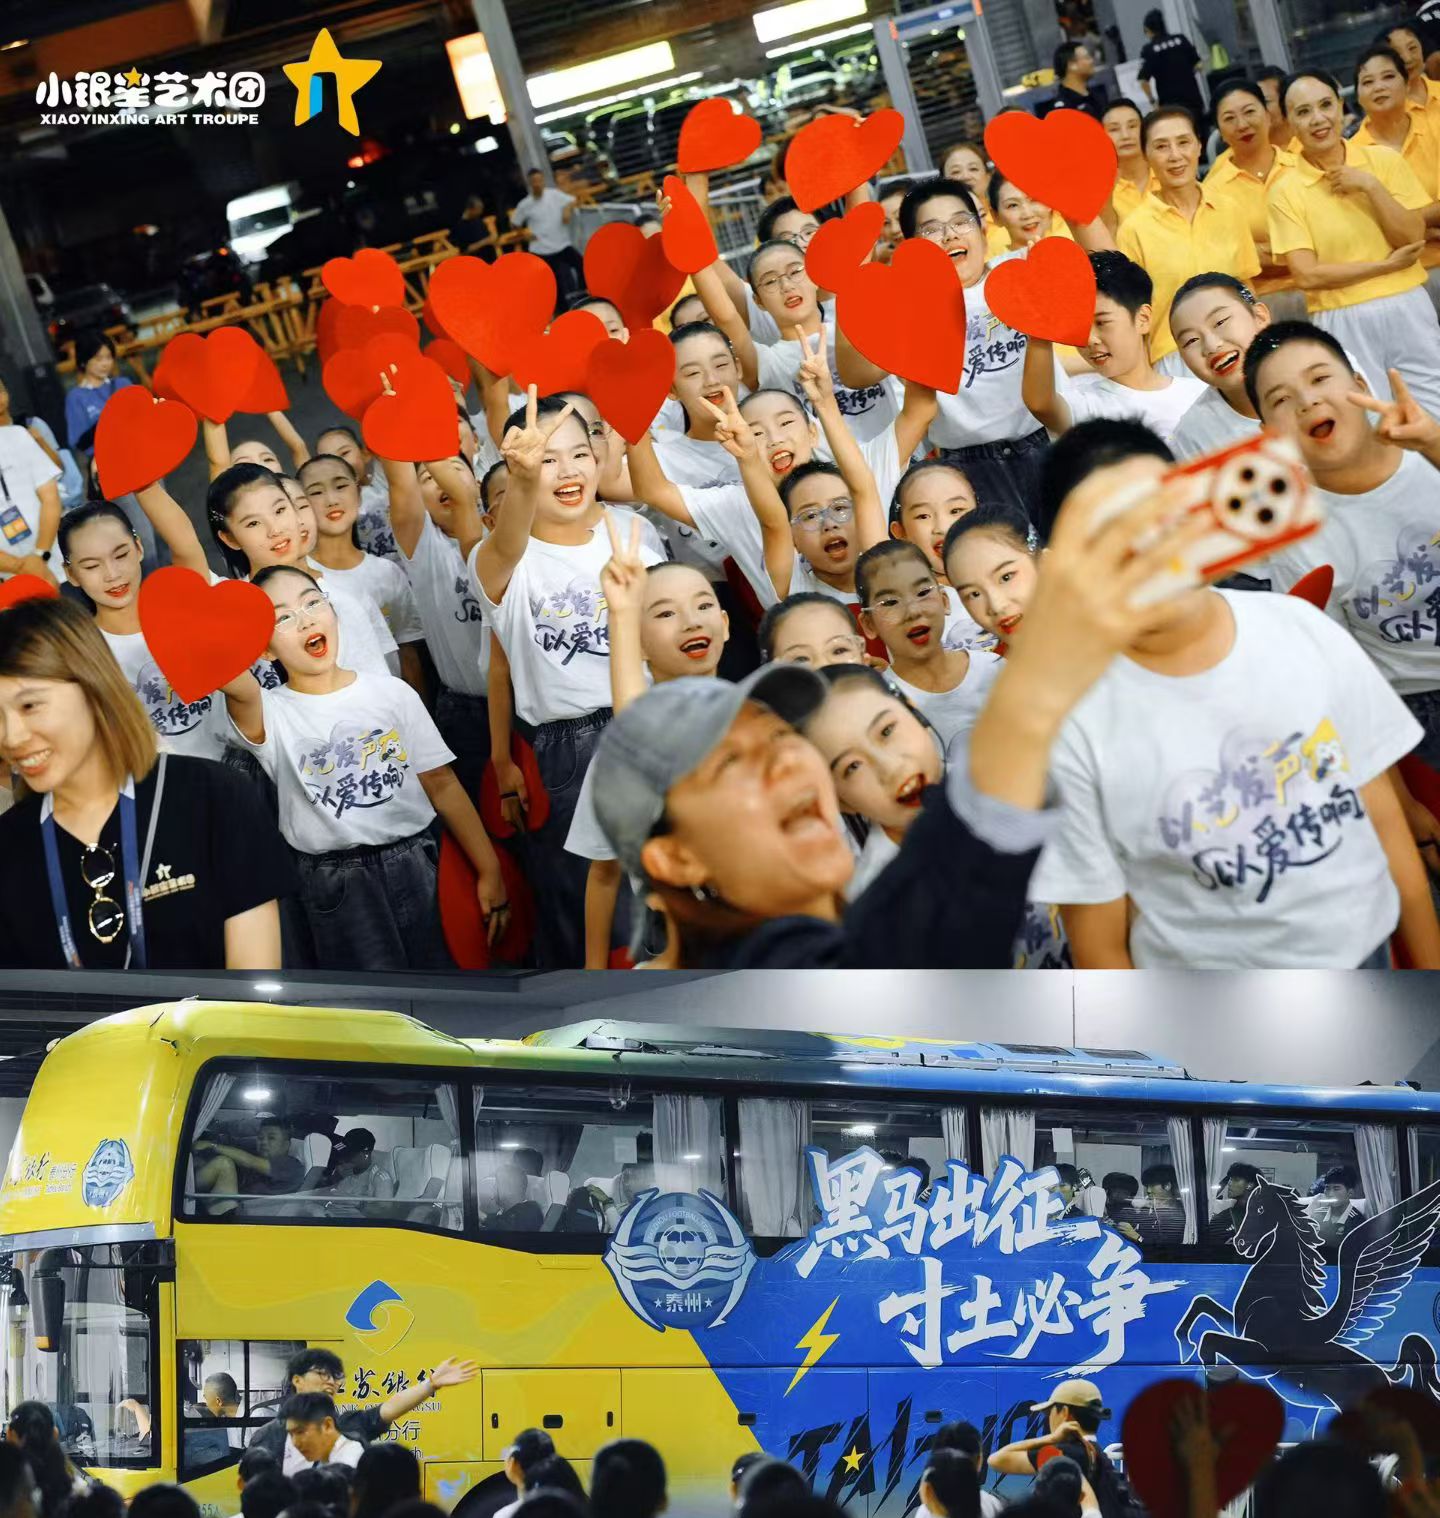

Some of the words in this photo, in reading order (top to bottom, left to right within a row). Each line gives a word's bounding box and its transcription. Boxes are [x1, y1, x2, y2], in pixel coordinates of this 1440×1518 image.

[963, 333, 1028, 388] 爱传响
[795, 1146, 1101, 1279] 黑马出征
[666, 1293, 702, 1313] 泰州
[879, 1231, 1190, 1380] 寸土必争
